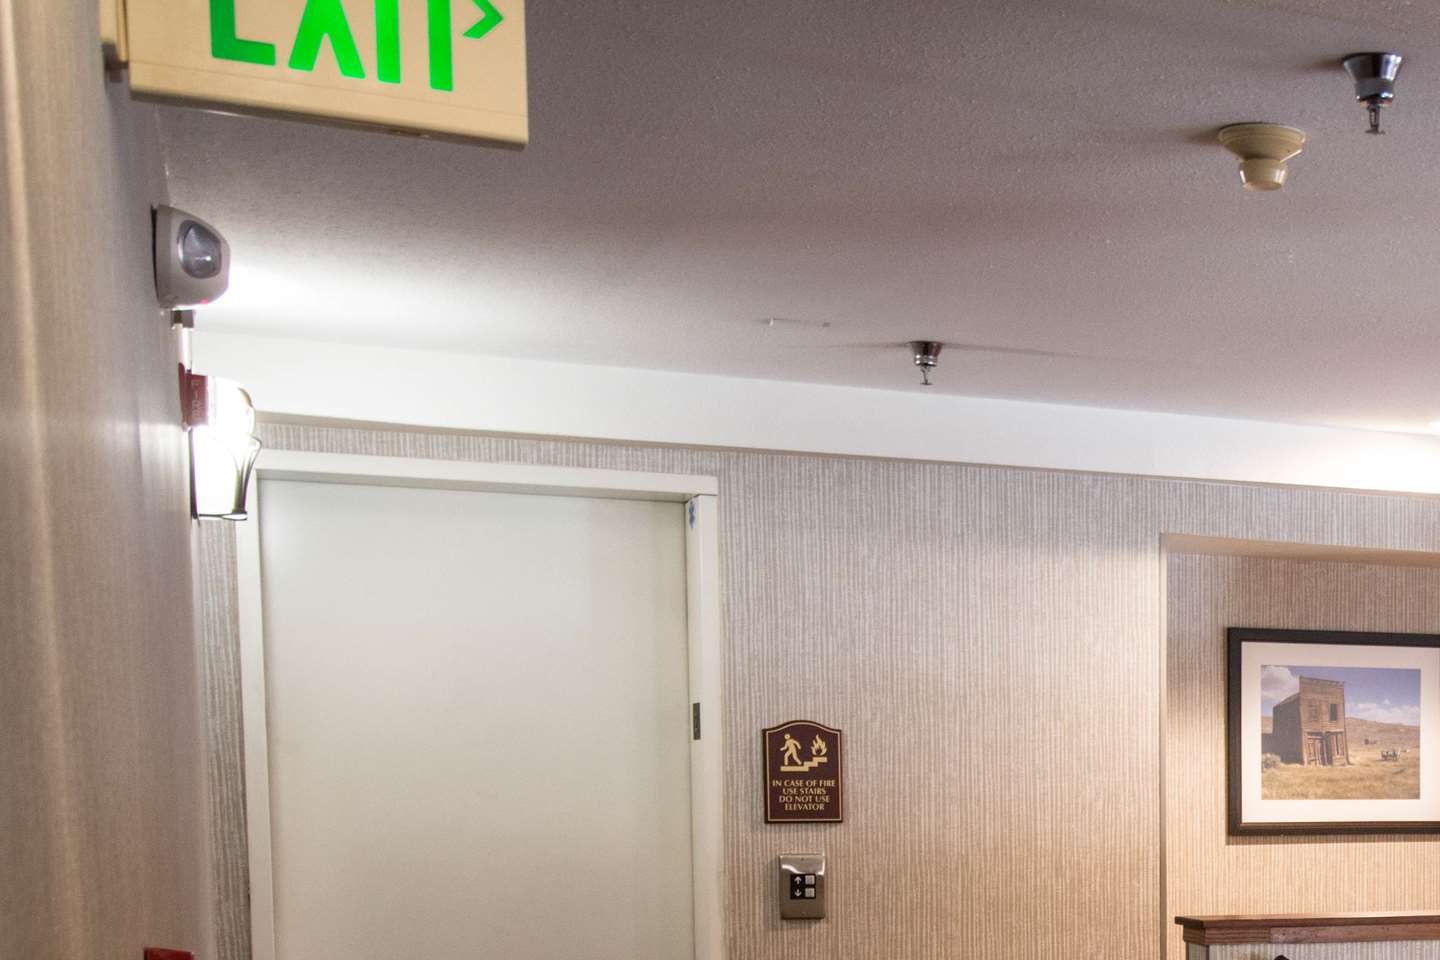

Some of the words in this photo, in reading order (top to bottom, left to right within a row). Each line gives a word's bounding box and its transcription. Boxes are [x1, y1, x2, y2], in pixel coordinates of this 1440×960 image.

[779, 795, 794, 803] DO
[795, 795, 812, 803] NOT
[816, 795, 829, 803] USE
[785, 803, 825, 811] ELEVATOR
